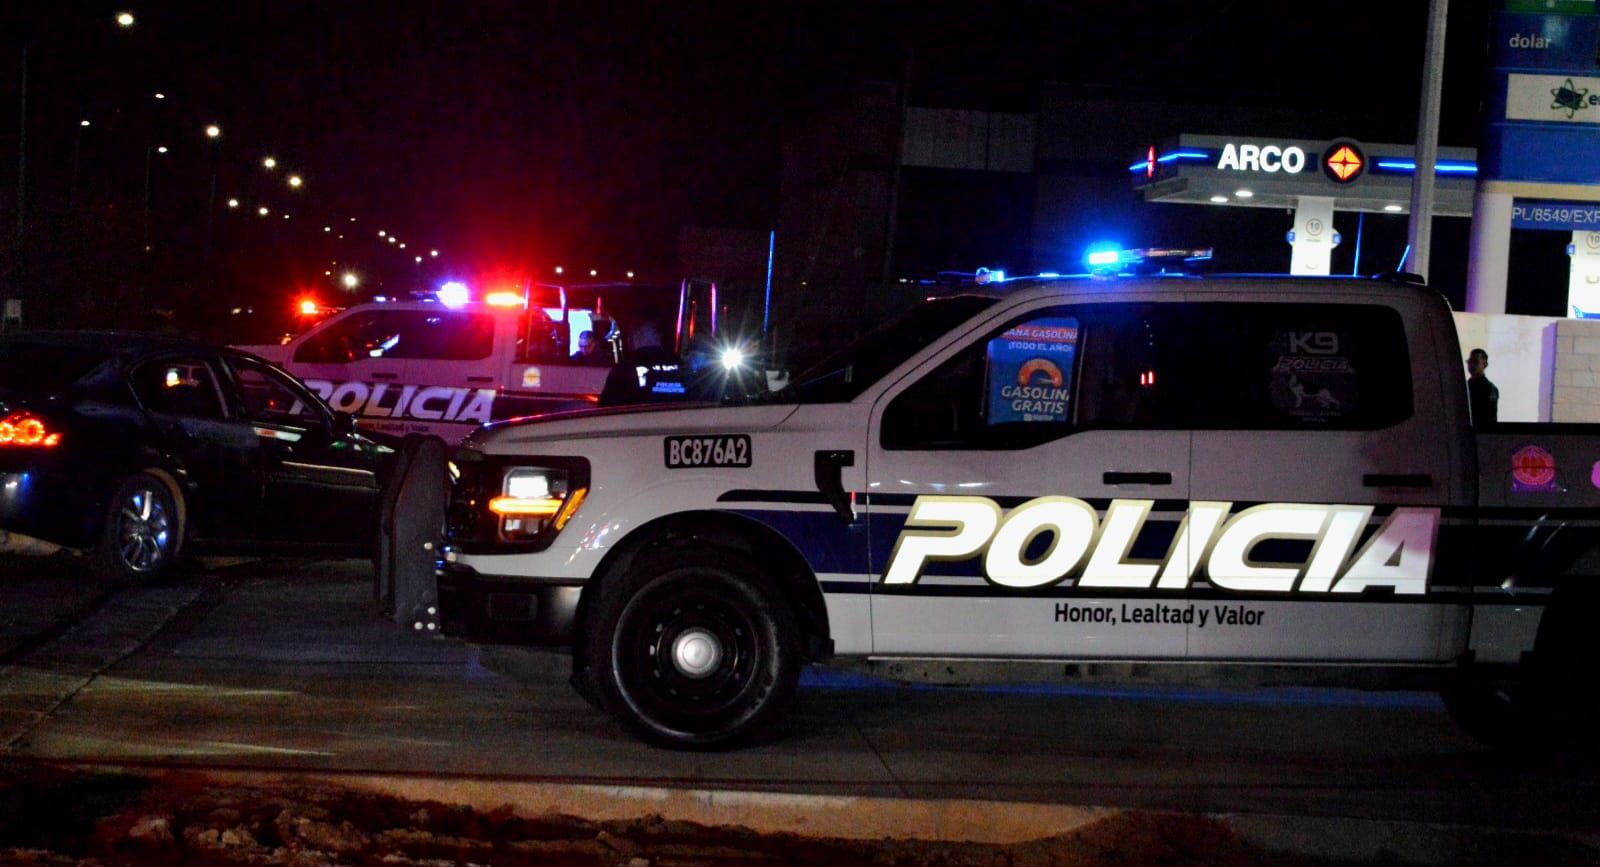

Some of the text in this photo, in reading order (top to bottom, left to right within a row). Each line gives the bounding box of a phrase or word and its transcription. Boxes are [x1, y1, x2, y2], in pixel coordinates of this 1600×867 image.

[1508, 33, 1552, 49] dolar
[1217, 143, 1305, 174] ARCO
[1003, 328, 1030, 338] ANA
[1288, 331, 1339, 354] K9
[1038, 343, 1048, 351] EL
[1011, 400, 1065, 414] GRATIS
[669, 438, 748, 465] BC876A2
[880, 495, 1440, 595] POLICIA
[1055, 603, 1264, 628] Honor, Lealtad y Valor
